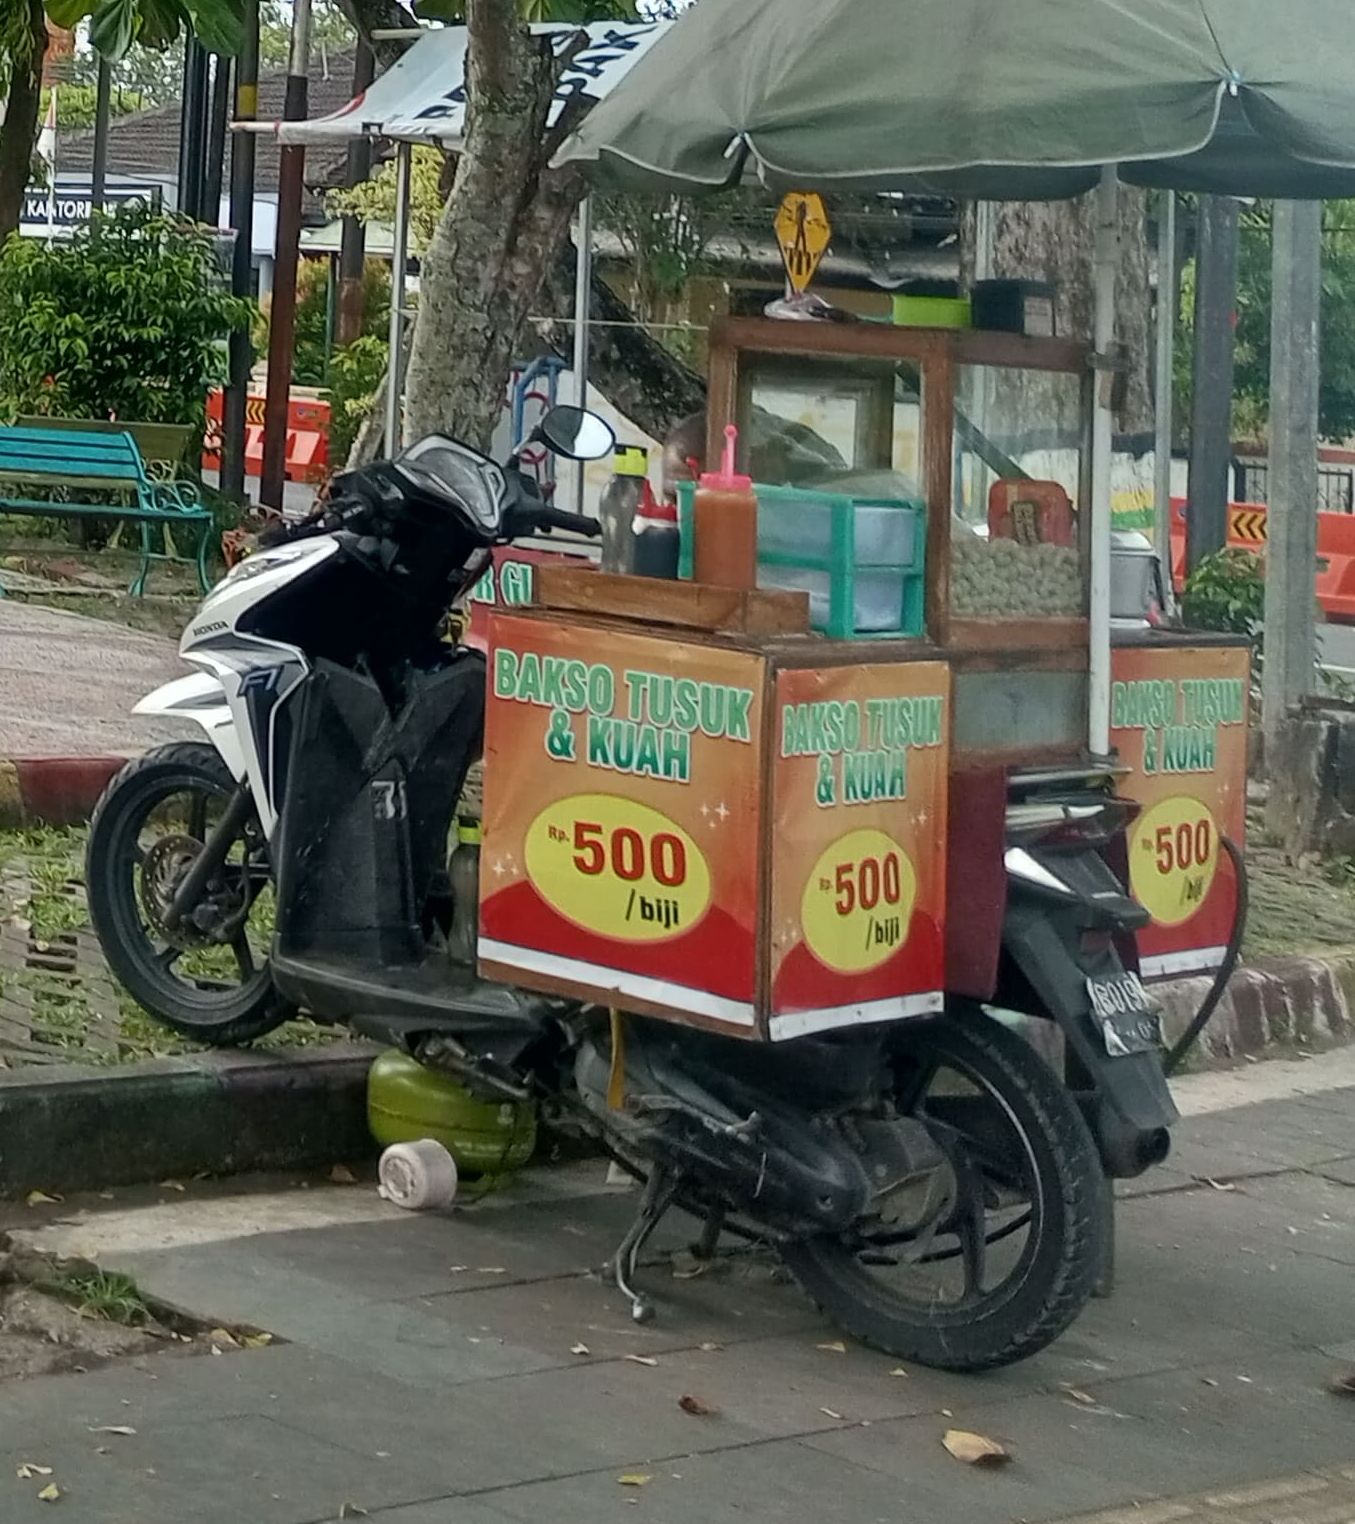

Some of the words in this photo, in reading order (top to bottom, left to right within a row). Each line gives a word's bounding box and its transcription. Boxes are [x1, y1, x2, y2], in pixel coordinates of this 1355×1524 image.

[494, 648, 614, 717] BAKSO
[624, 669, 753, 743] TUSUK
[781, 700, 860, 758] BAKSO
[865, 695, 943, 750] TUSUK
[1112, 679, 1176, 729] BAKSO
[545, 708, 577, 762] &
[587, 716, 690, 783] KUAH
[815, 753, 836, 808] &
[842, 748, 907, 806] KUAH
[572, 820, 687, 888] 500
[1155, 819, 1210, 874] 500
[625, 888, 680, 929] /biji
[835, 851, 900, 916] 500
